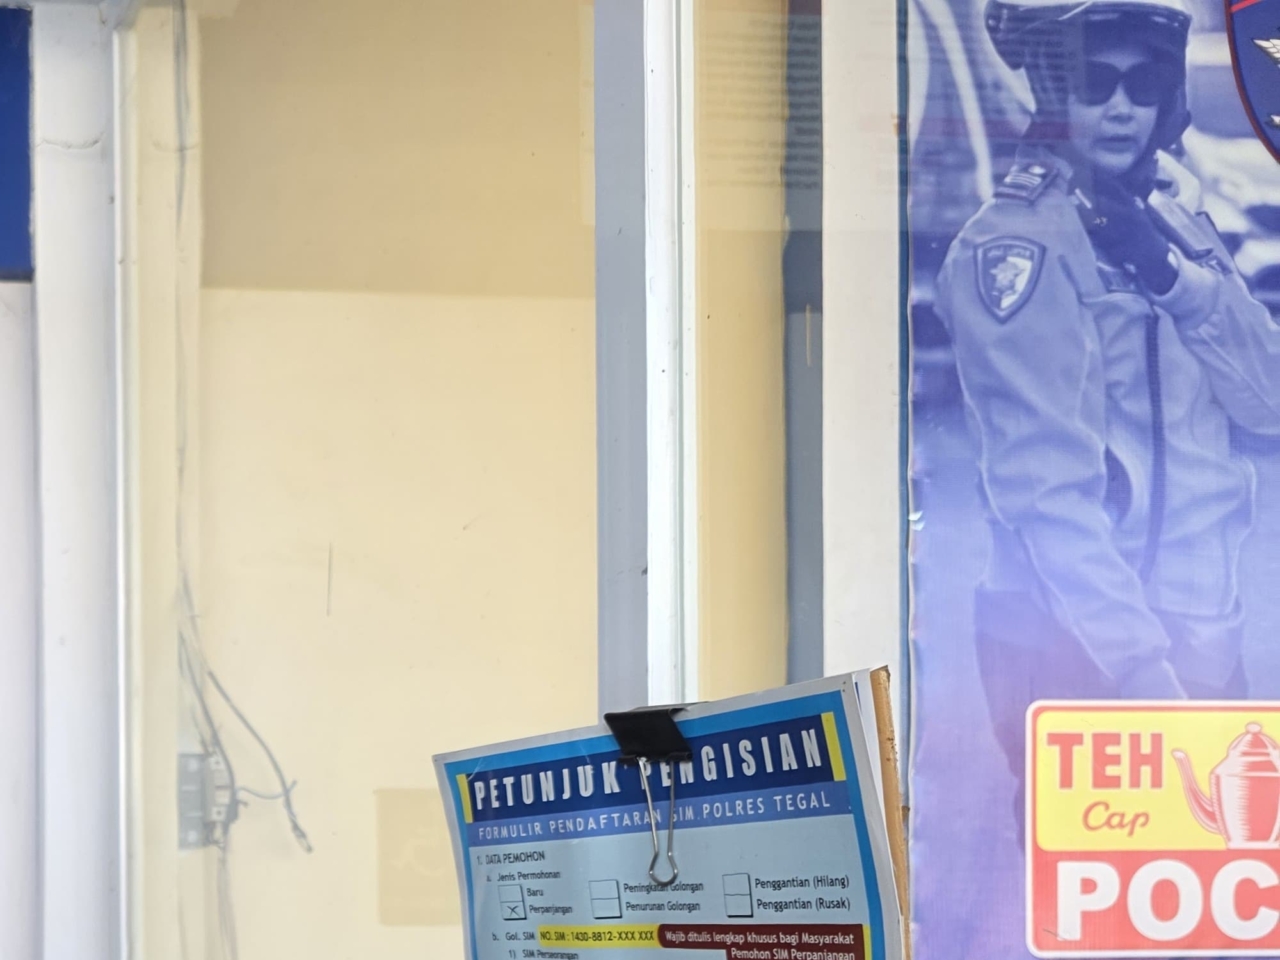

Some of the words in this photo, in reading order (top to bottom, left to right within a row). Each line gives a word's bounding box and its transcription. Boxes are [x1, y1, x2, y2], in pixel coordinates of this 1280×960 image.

[1046, 733, 1163, 789] TEH
[474, 761, 620, 810] PETUNJUK
[479, 823, 542, 840] FORMULIR
[550, 809, 661, 833] PENDAFTARAN
[703, 797, 765, 818] POLRES
[773, 791, 830, 812] TEGAL
[1082, 801, 1150, 838] Cap
[486, 854, 501, 865] DATA
[503, 851, 545, 864] PEMOHON
[518, 870, 560, 880] Permohonan
[755, 878, 810, 889] Penggantian
[813, 875, 849, 889] (Hilang)
[527, 888, 543, 896] Baru
[529, 905, 572, 915] Perpanjangan
[626, 902, 665, 912] Penurunan
[666, 902, 700, 912] Golongan
[757, 899, 813, 911] Penggantian
[815, 897, 850, 911] (Rusak)
[638, 931, 654, 941] XXX
[664, 931, 685, 943] Wajib
[687, 931, 711, 942] ditulis
[713, 931, 744, 945] lengkap
[747, 932, 777, 943] khusus
[779, 932, 799, 946] bagi
[801, 932, 854, 946] Masyarakat
[731, 948, 771, 959] Pemohon
[773, 949, 789, 960] SIM
